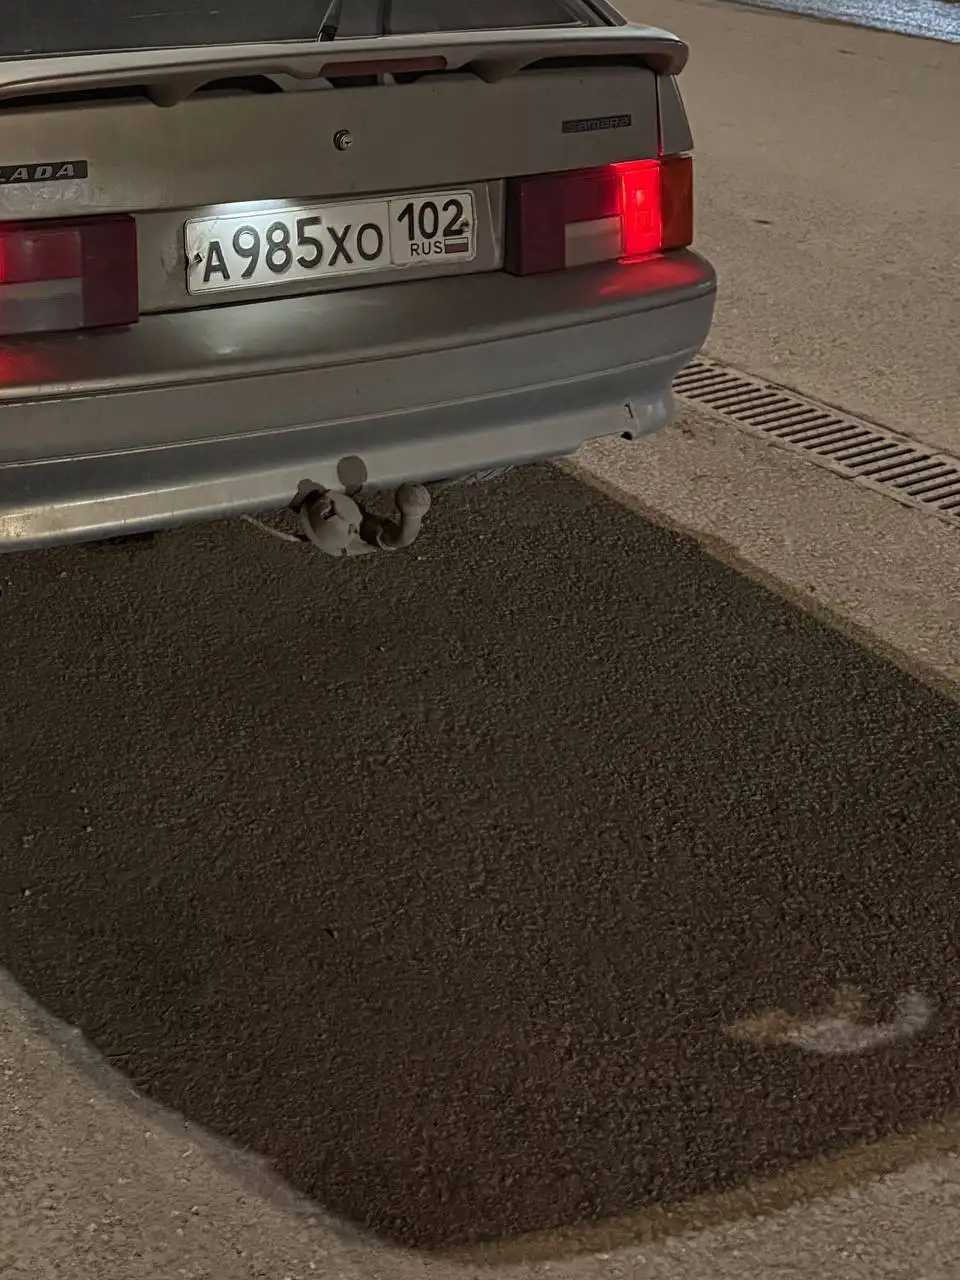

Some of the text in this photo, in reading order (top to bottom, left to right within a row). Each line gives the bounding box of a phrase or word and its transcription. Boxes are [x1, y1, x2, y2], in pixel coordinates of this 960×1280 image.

[202, 198, 465, 283] А985ХО 102
[410, 239, 444, 257] RUS
